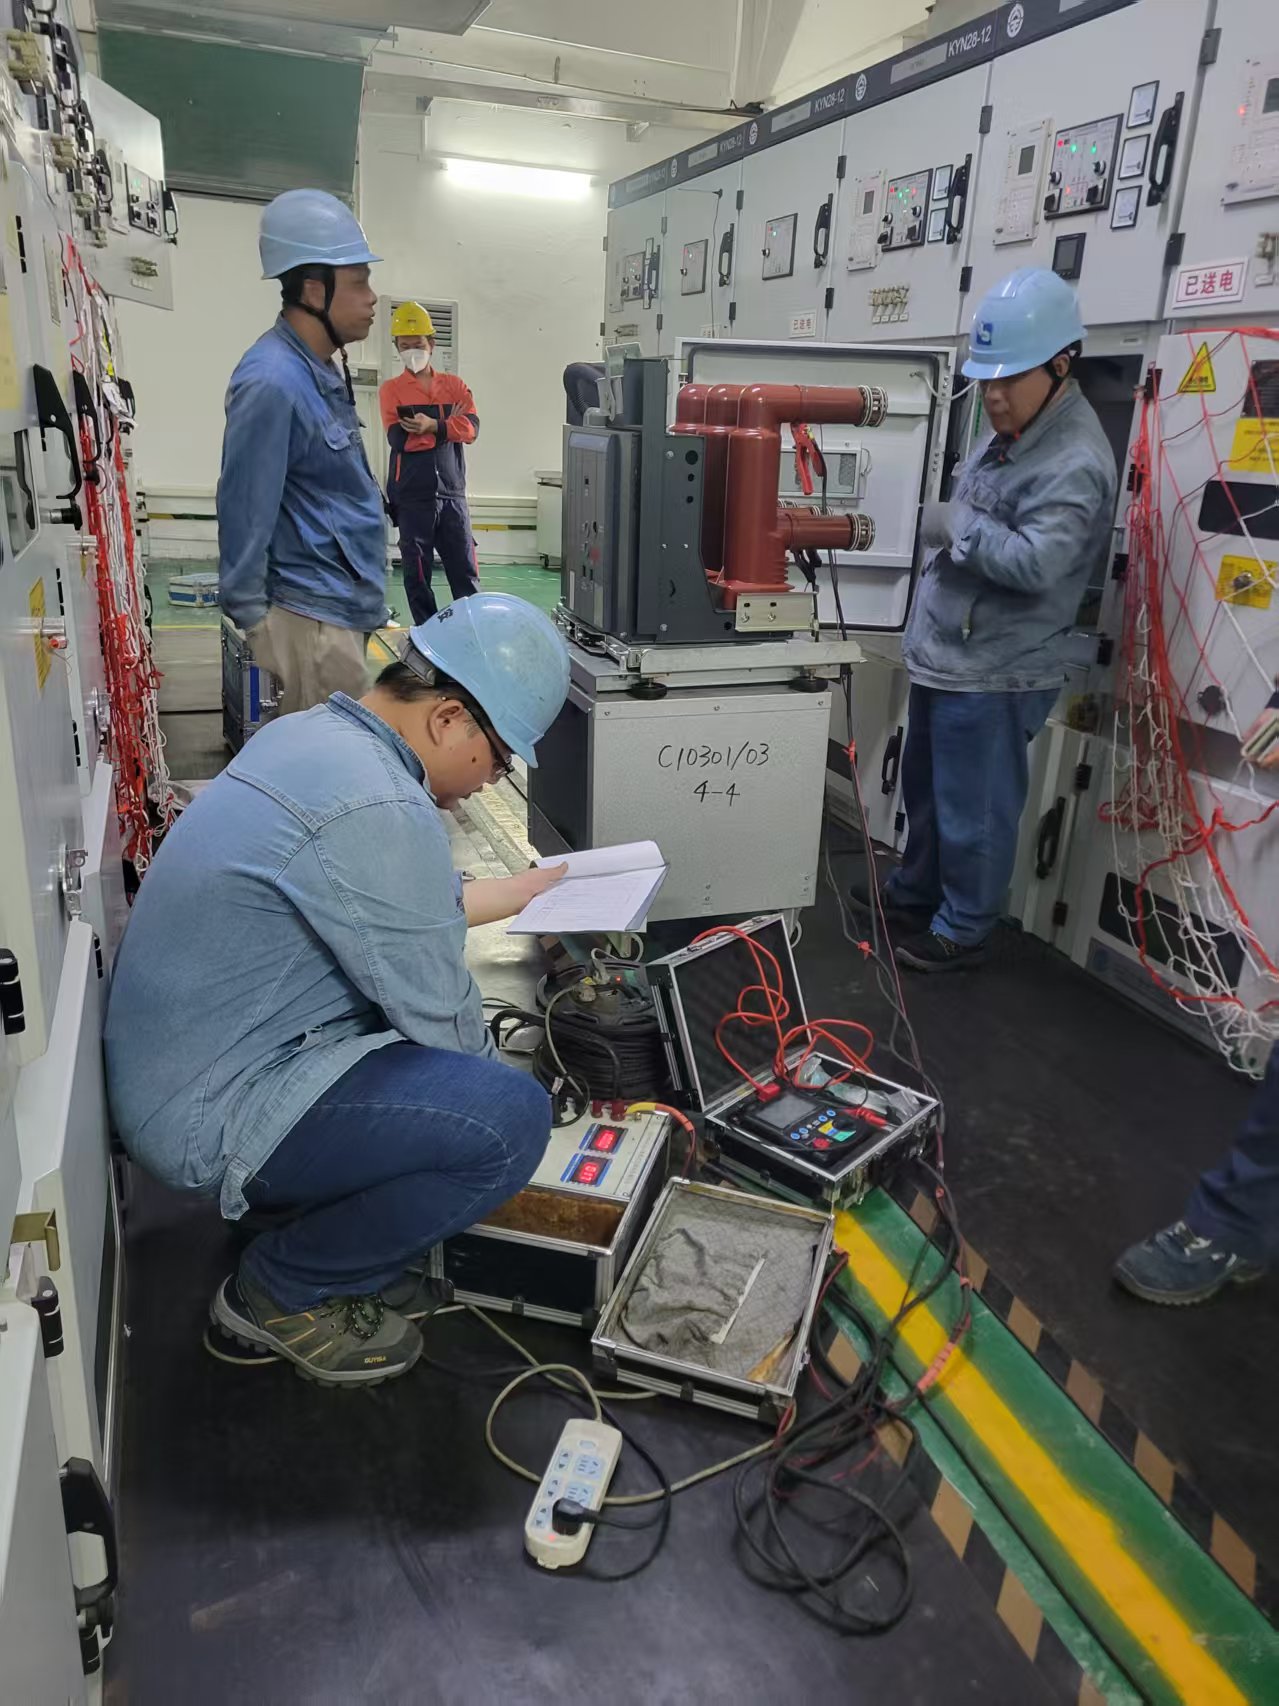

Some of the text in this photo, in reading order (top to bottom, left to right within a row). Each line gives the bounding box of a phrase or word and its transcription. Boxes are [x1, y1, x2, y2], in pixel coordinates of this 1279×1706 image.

[948, 25, 992, 57] KYN28-12
[815, 88, 845, 113] KYN28-12
[1185, 270, 1233, 296] 已送电
[658, 741, 770, 771] C10301/03
[693, 780, 741, 807] 4-4
